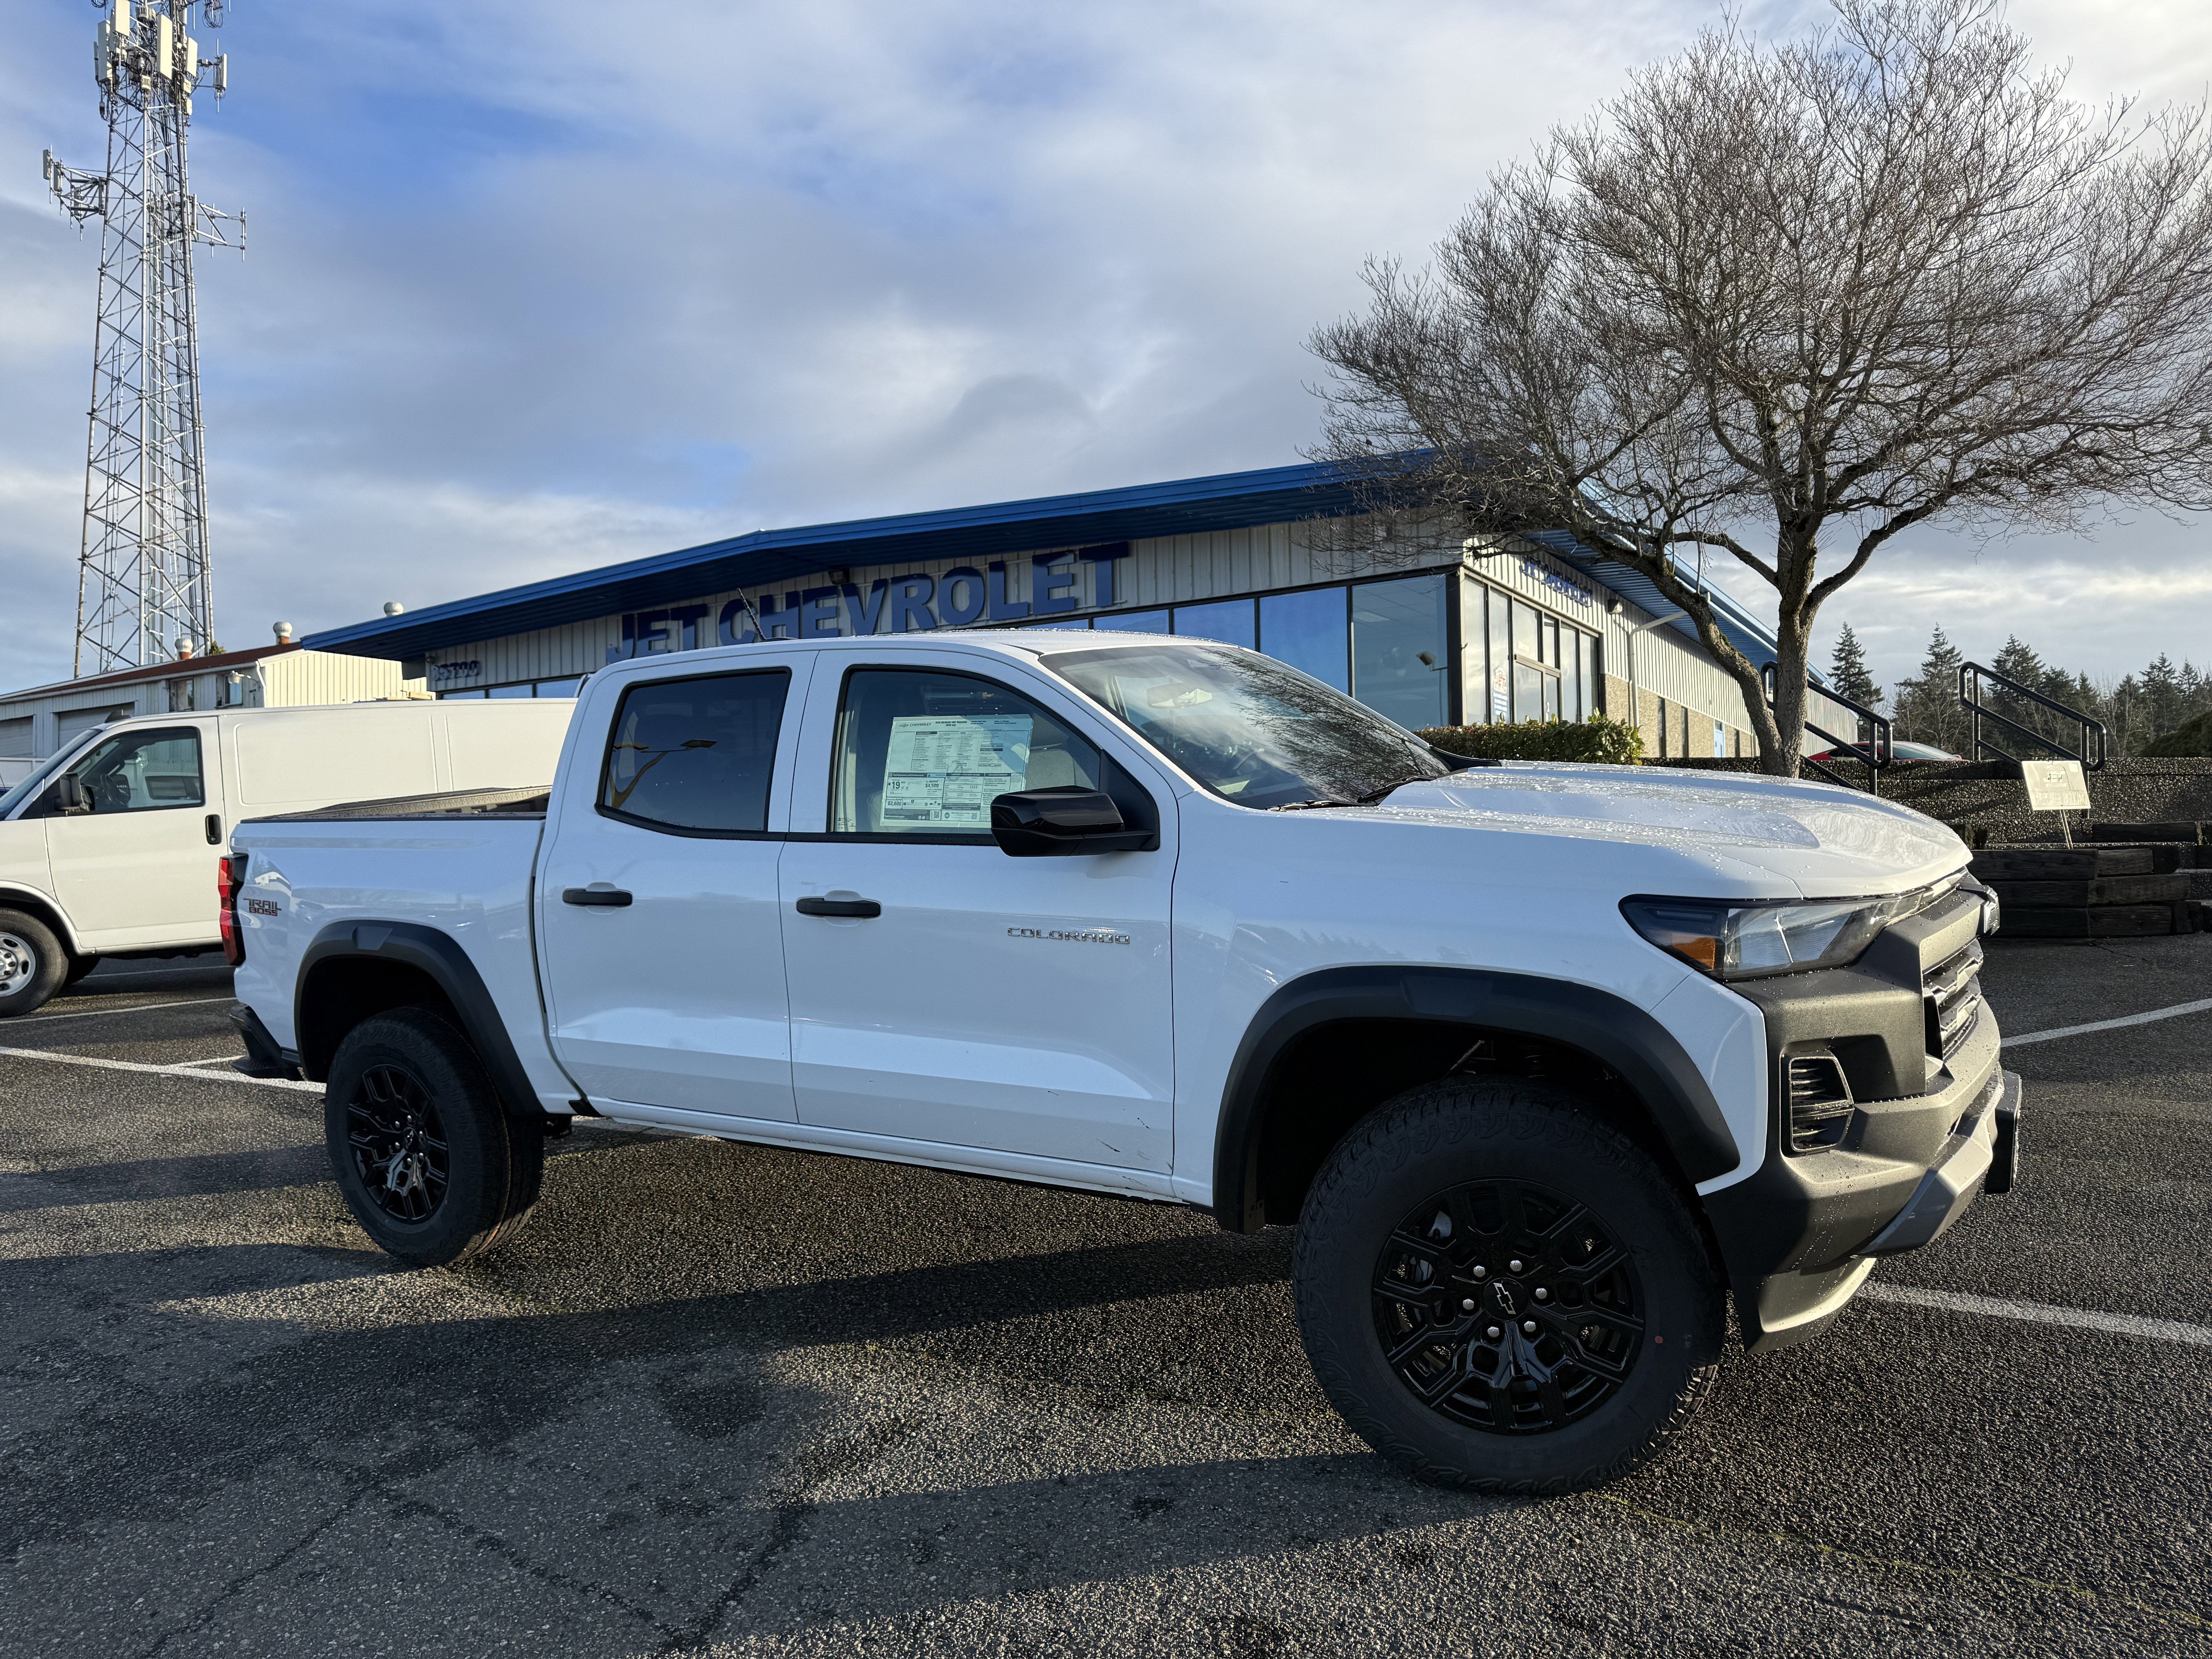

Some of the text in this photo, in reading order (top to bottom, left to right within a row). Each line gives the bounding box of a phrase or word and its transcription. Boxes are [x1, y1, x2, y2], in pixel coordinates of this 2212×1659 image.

[606, 541, 1128, 664] JET CHEVROLET
[243, 898, 282, 910] TRAIL
[249, 907, 278, 916] BOSS
[1007, 927, 1130, 944] COLORADO
